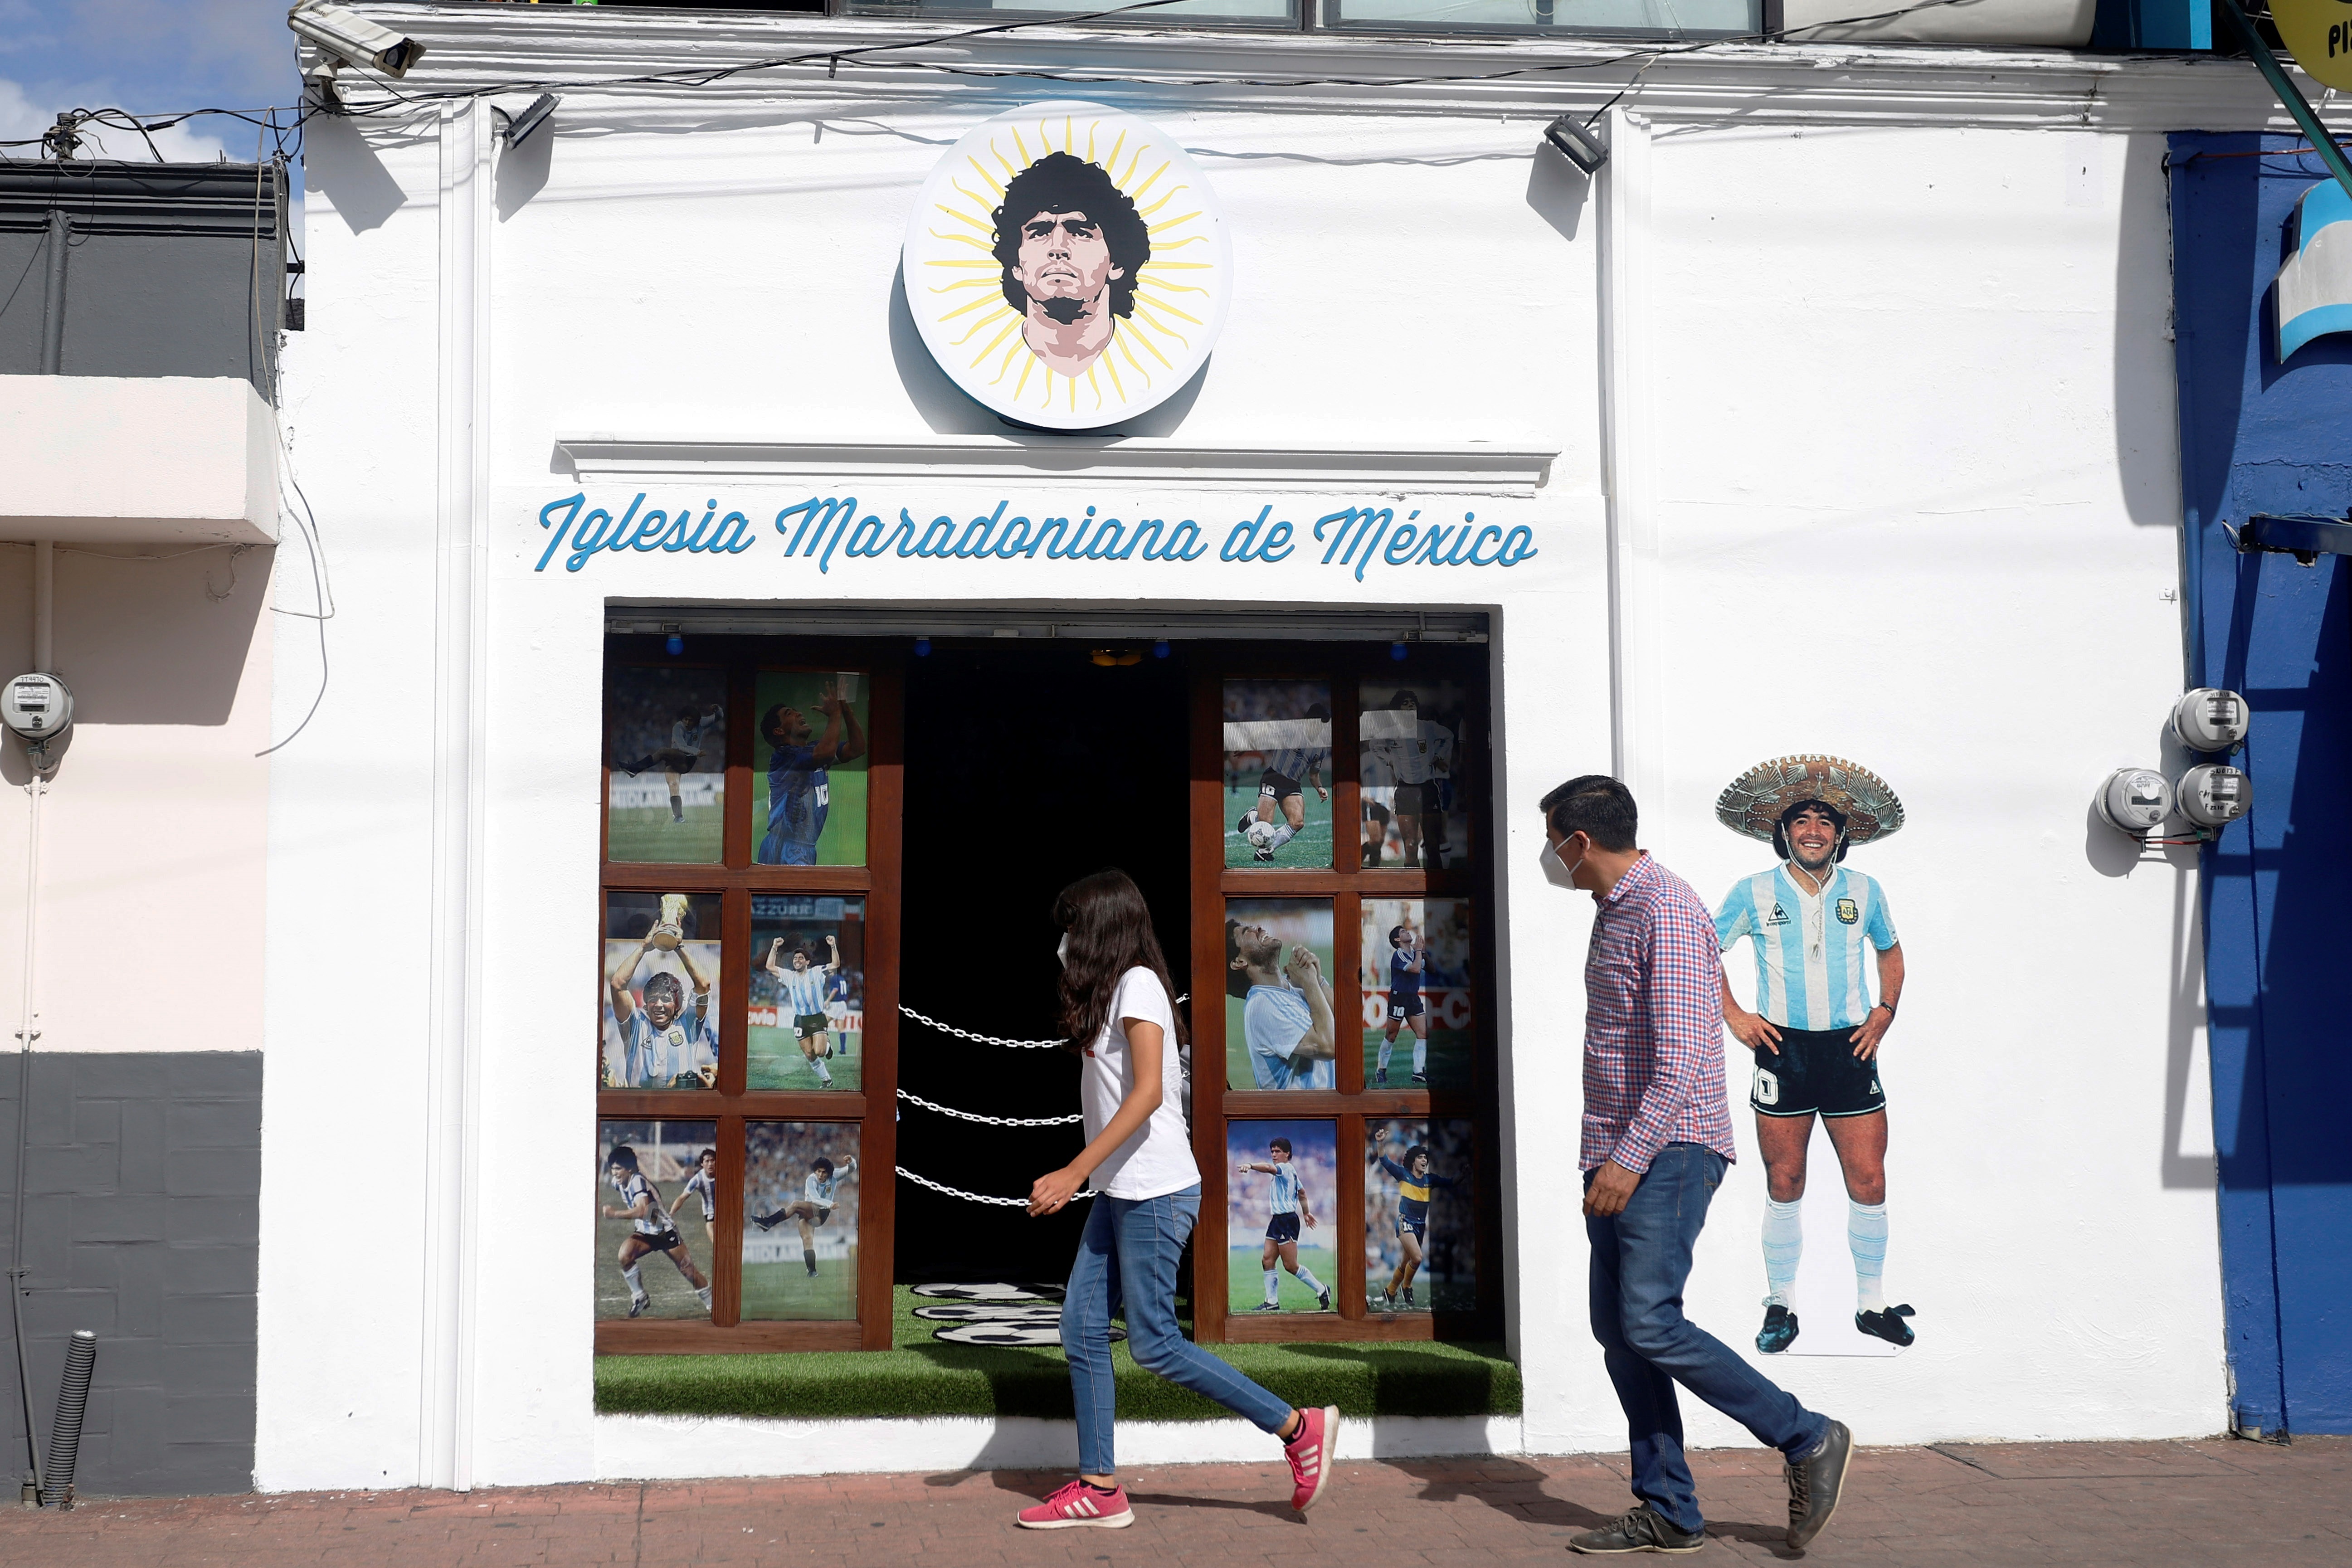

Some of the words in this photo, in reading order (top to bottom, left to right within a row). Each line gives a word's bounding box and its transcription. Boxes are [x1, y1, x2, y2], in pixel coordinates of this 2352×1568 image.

[309, 5, 326, 17] Bolide
[2328, 19, 2352, 58] PI
[535, 493, 756, 572] Iglesia
[775, 497, 1209, 573] Maradoniana
[1220, 505, 1295, 562] de
[1314, 506, 1539, 581] México
[815, 784, 828, 807] 10
[839, 980, 847, 995] 11
[1393, 1006, 1405, 1017] 10
[1403, 1222, 1413, 1231] 10
